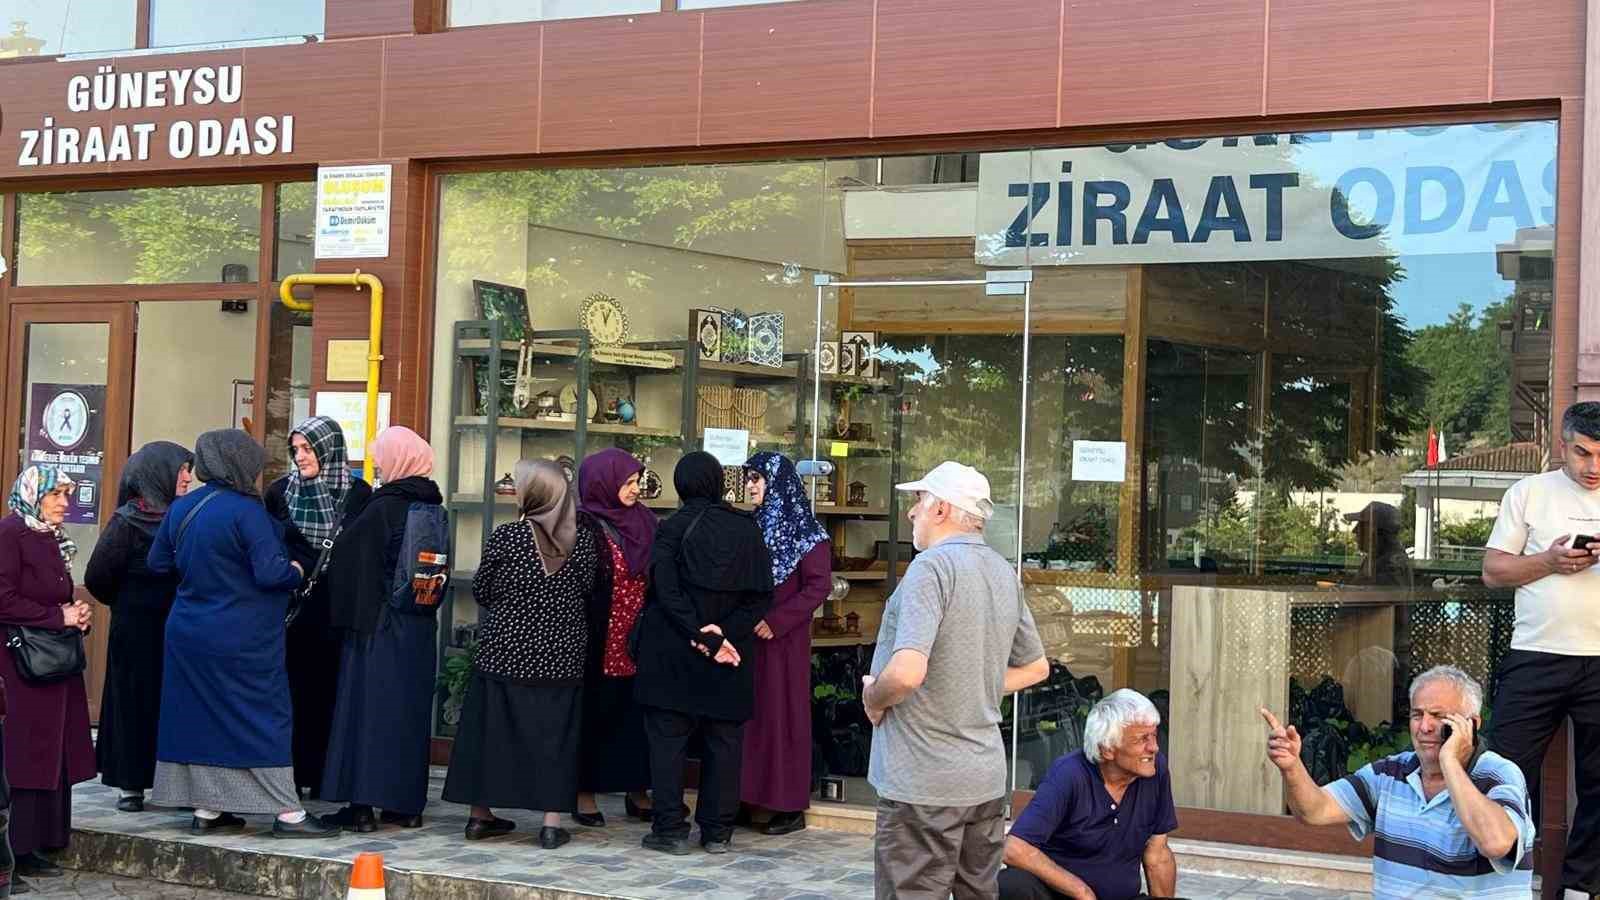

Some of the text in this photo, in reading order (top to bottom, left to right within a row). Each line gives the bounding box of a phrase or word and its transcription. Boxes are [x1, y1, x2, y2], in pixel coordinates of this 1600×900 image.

[67, 65, 243, 112] GÜNEYSU
[18, 115, 294, 166] ZİRAAT ODASI
[1005, 160, 1300, 248] ZİRAAT
